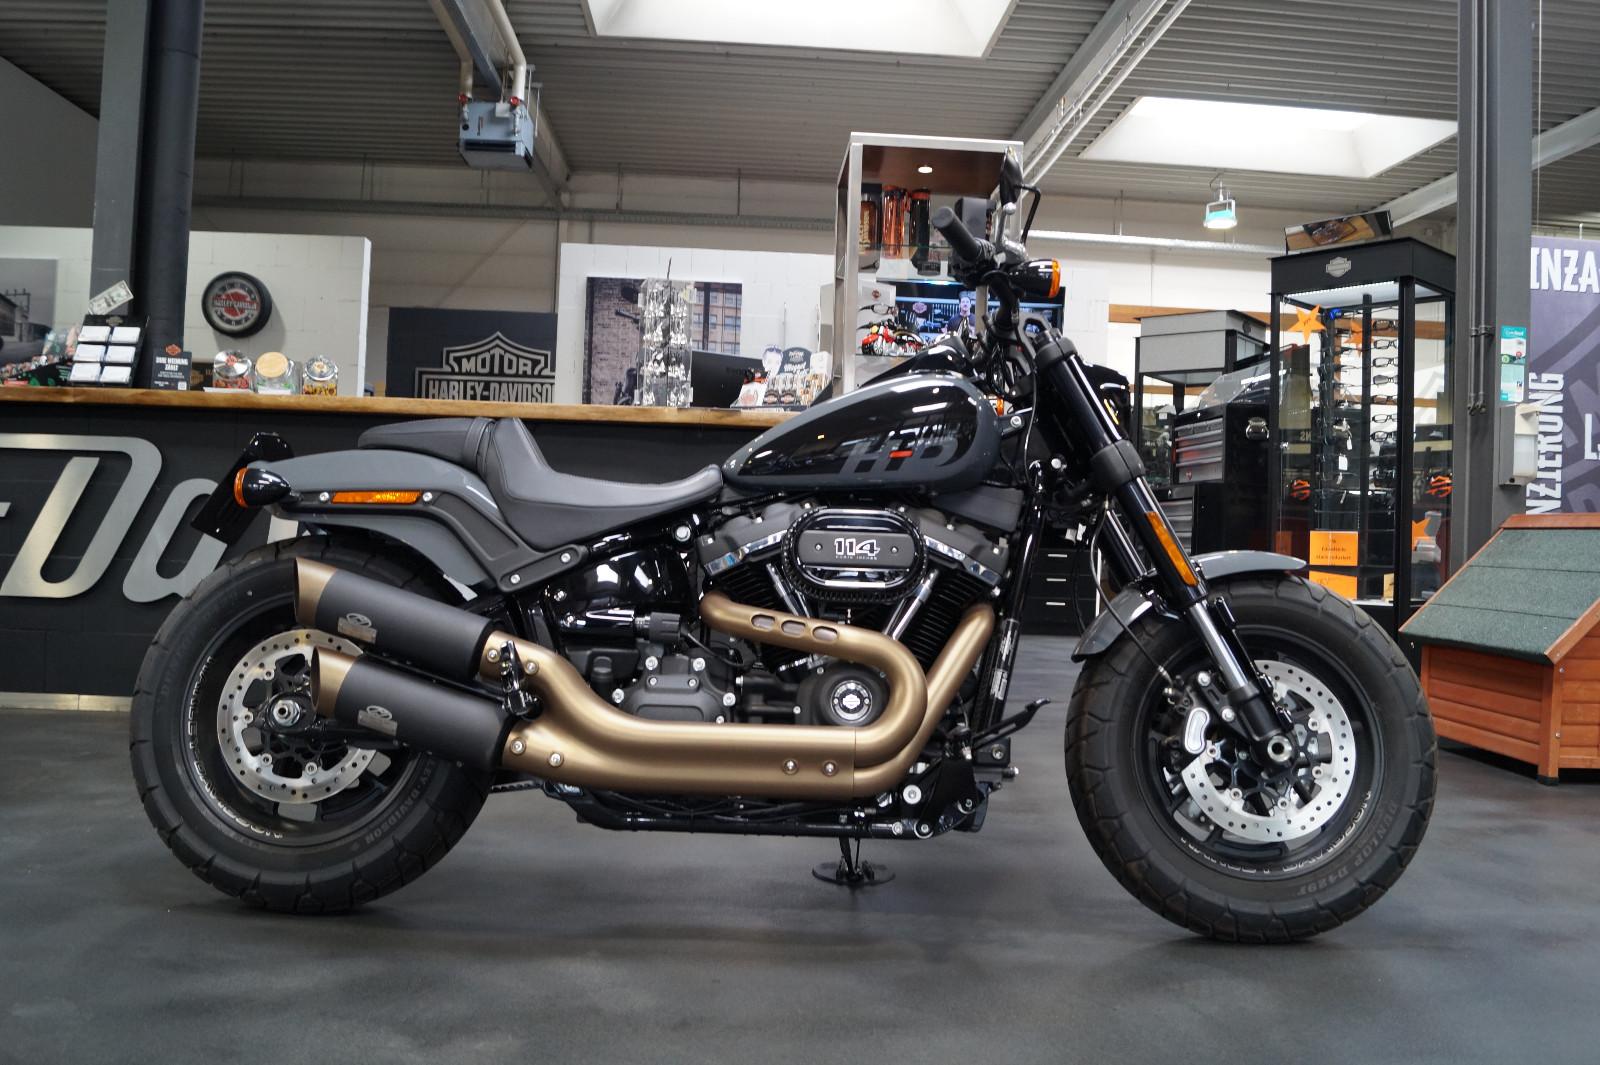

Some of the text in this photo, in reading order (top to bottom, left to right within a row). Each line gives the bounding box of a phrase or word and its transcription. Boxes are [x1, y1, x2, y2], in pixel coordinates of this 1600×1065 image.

[1530, 247, 1600, 294] INZA
[461, 347, 532, 376] MOTOR
[428, 380, 555, 403] HARLEY-DAVIDSO
[1584, 413, 1600, 460] L
[834, 538, 881, 556] 114
